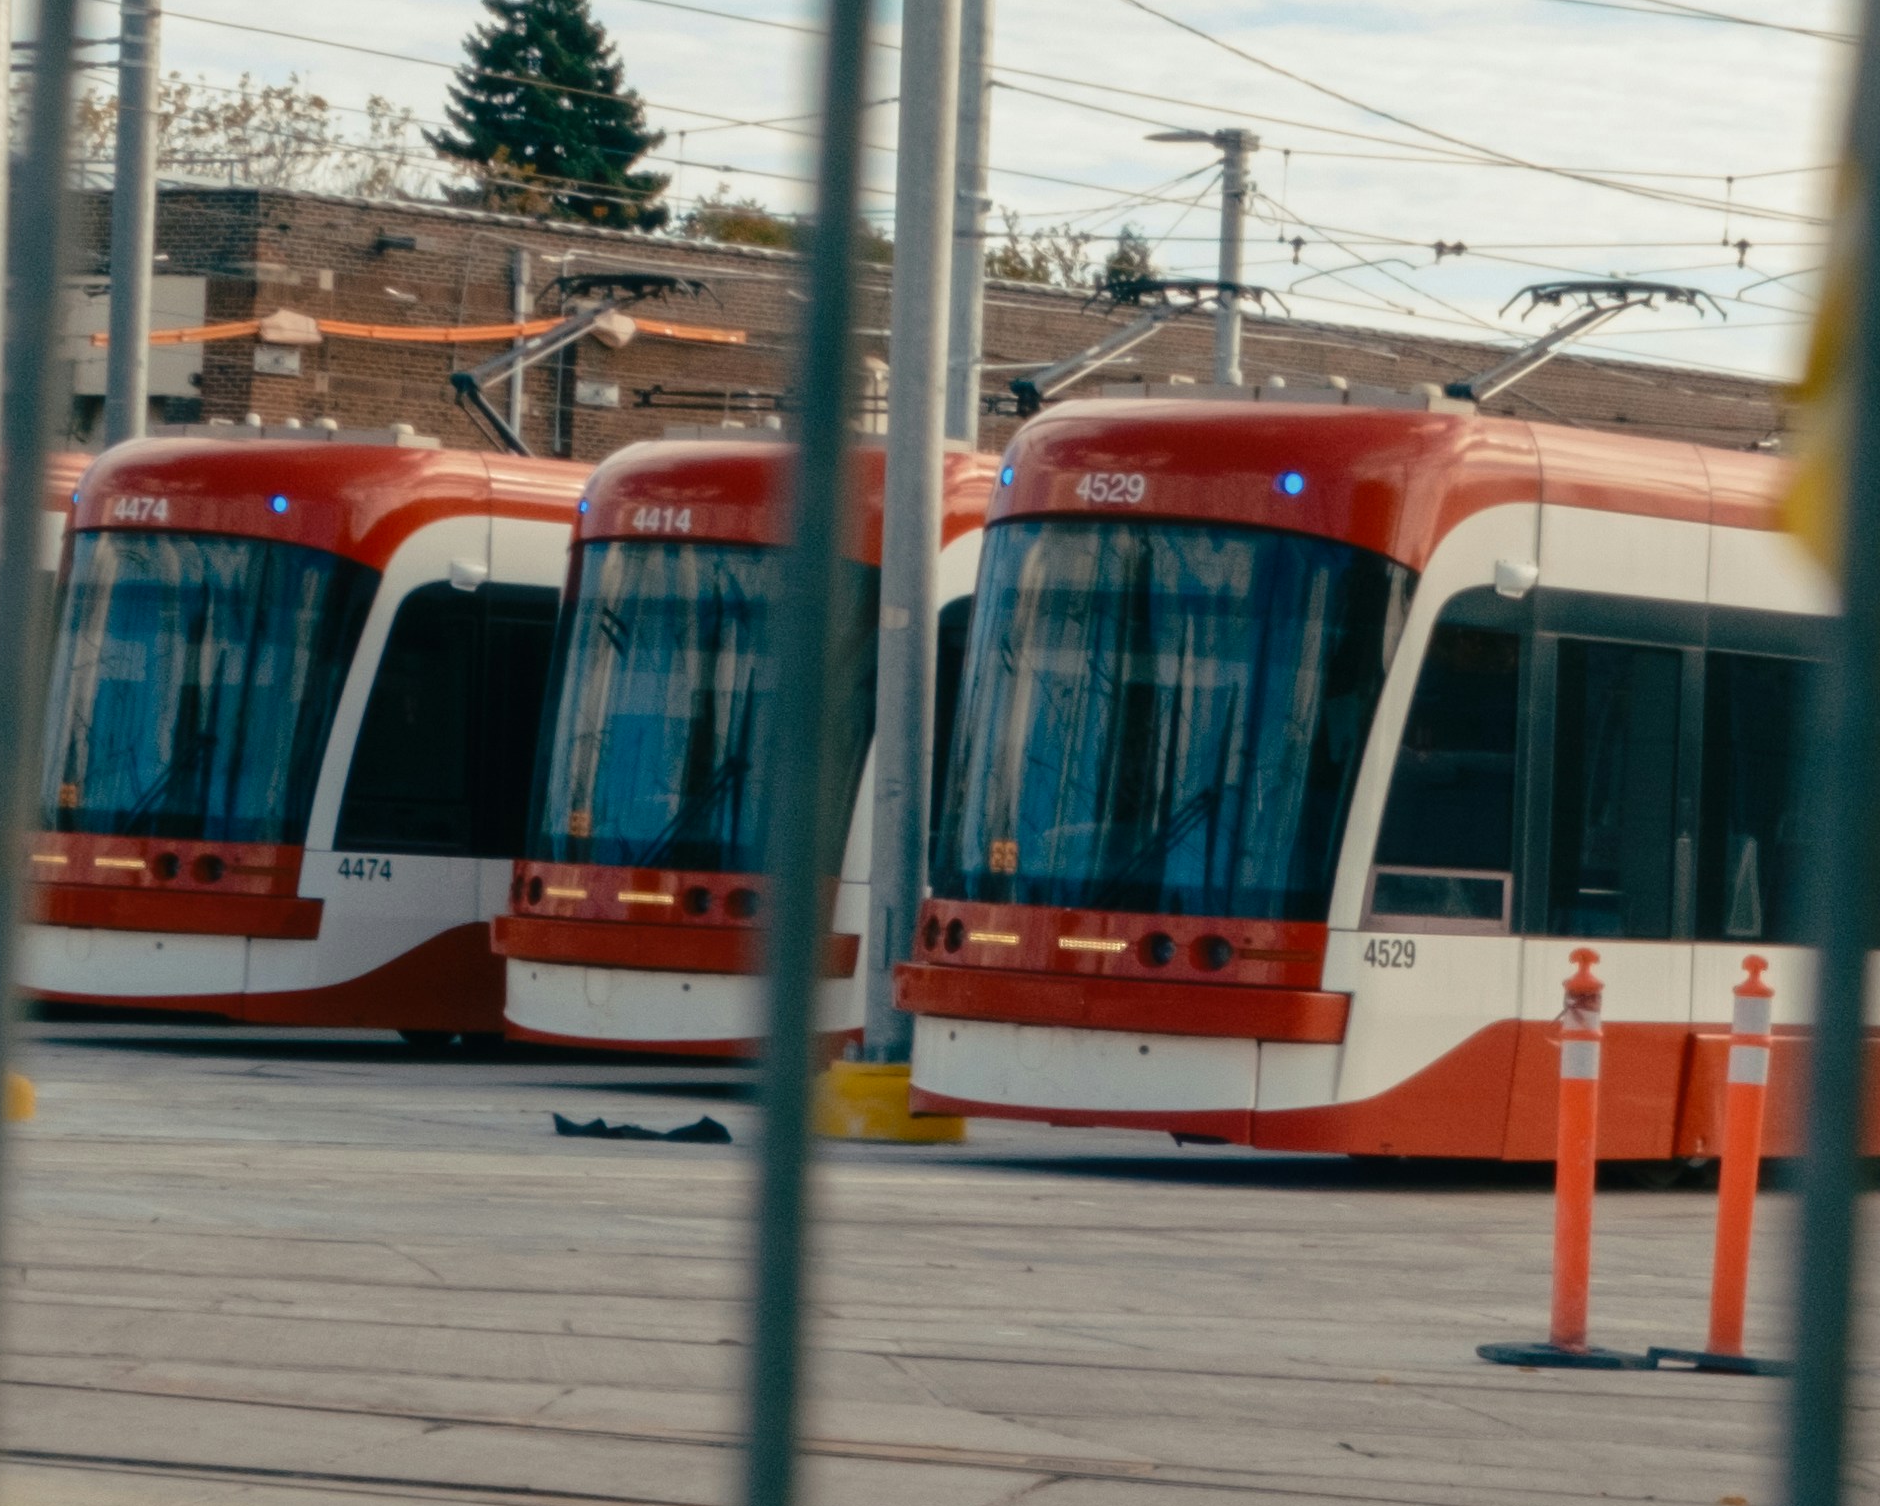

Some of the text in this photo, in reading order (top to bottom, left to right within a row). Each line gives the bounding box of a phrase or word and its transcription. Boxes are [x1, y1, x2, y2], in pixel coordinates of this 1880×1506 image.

[1076, 472, 1146, 504] 4529
[114, 496, 168, 522] 4474
[632, 506, 692, 533] 4414
[337, 857, 392, 882] 4474
[1363, 938, 1417, 969] 4529
